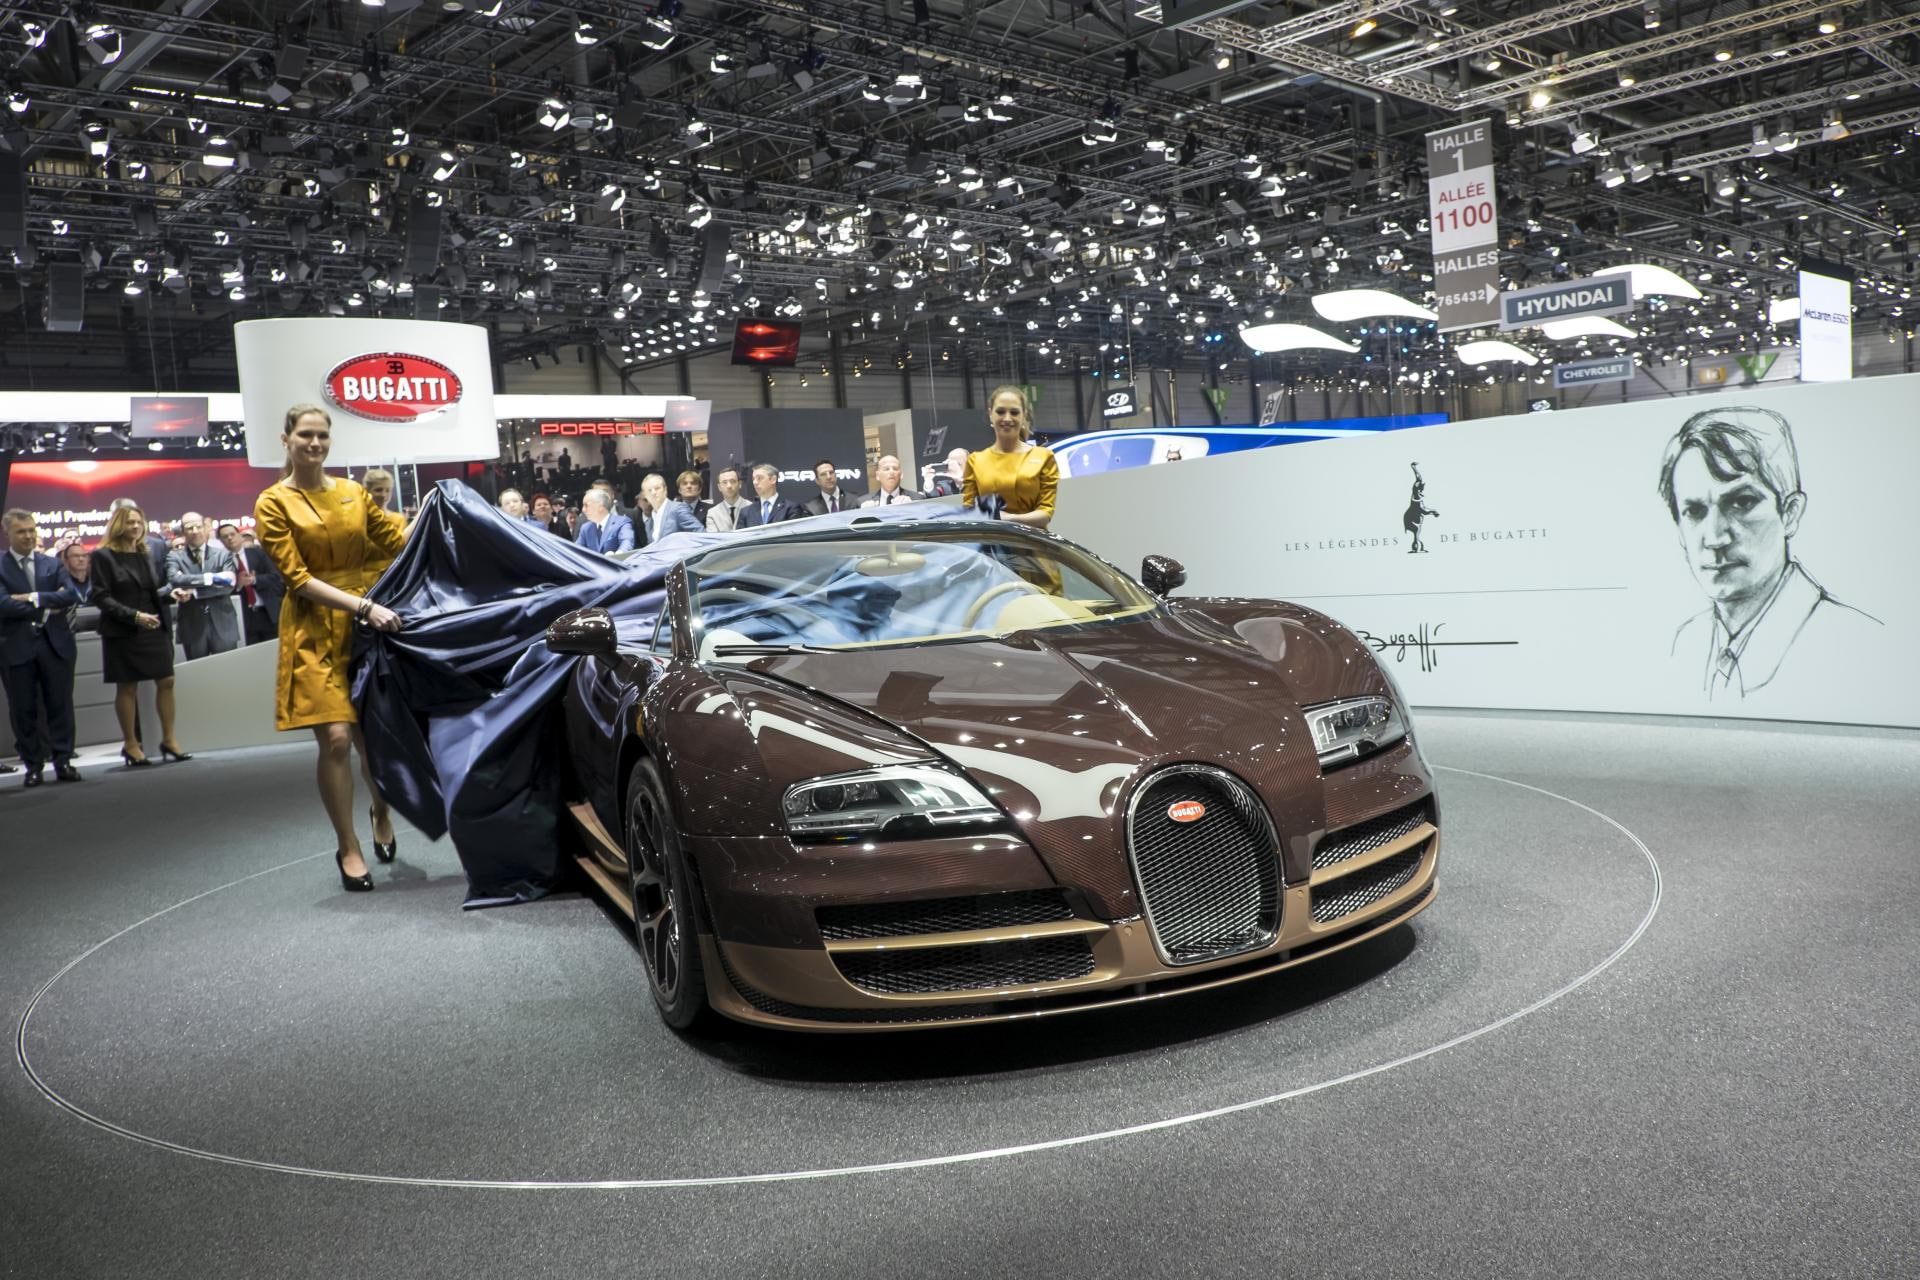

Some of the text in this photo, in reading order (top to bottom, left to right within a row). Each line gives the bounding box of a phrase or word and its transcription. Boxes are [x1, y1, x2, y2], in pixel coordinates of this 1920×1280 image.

[1433, 128, 1484, 152] HALLE
[1452, 148, 1465, 173] 1
[1438, 181, 1486, 205] ALLÉE
[1434, 201, 1494, 233] 1100
[1434, 250, 1498, 275] HALLES
[1438, 289, 1485, 307] 765432
[1517, 286, 1614, 316] HYUNDAI
[1563, 364, 1625, 380] CHEVROLET
[342, 376, 448, 402] BUGATTI
[540, 422, 665, 436] PORSCHE
[1285, 528, 1548, 552] LES LÉGENDES DE BUGATTI
[1172, 805, 1201, 818] BUGATTI
